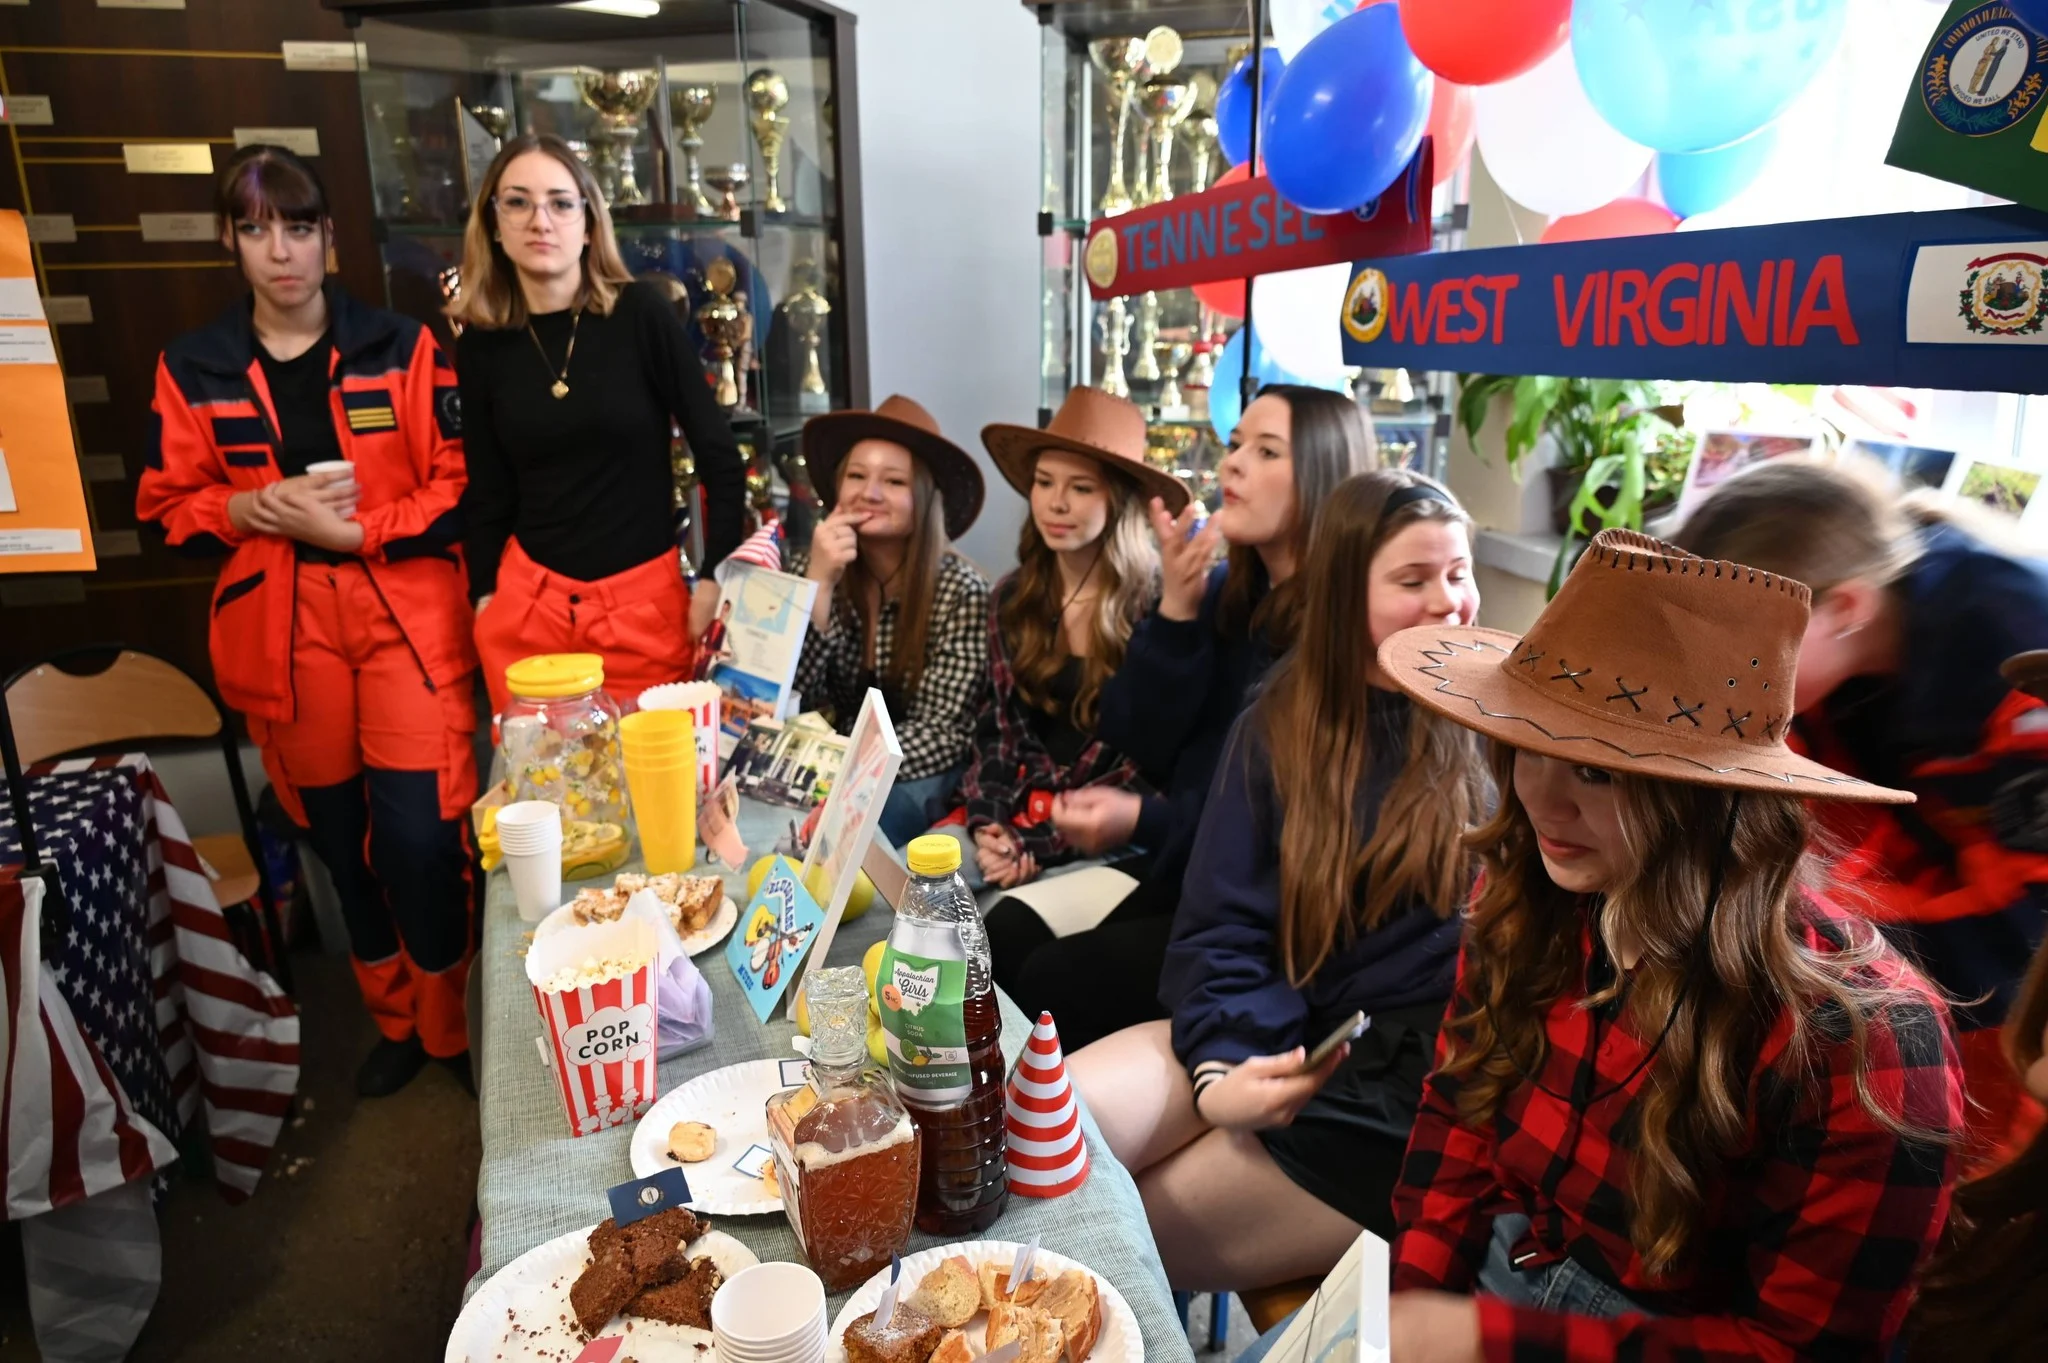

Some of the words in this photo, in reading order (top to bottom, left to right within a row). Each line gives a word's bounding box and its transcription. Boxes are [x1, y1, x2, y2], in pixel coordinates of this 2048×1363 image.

[1387, 274, 1519, 345] WEST
[1553, 255, 1859, 347] VIRGINIA
[737, 963, 754, 992] MUSIC
[894, 968, 935, 984] Appalachian
[899, 978, 929, 997] Girls
[587, 1021, 630, 1043] POP
[904, 1023, 925, 1032] CITRUS
[906, 1030, 924, 1038] SODA
[578, 1031, 639, 1059] CORN
